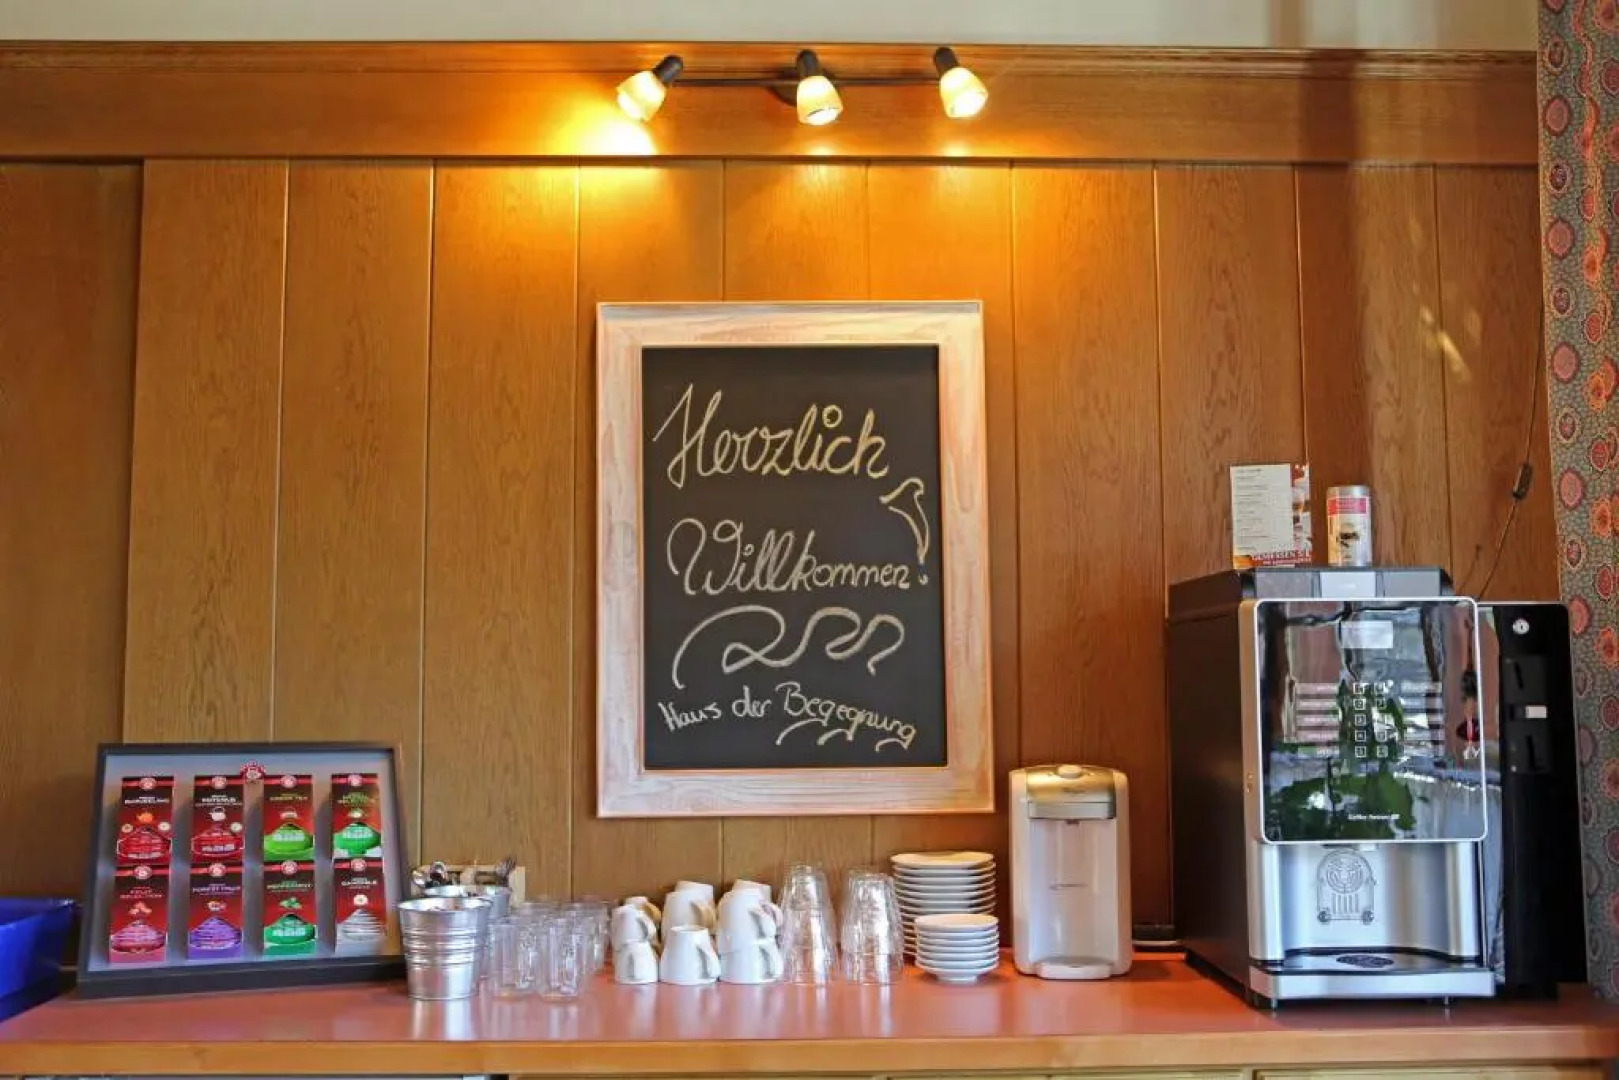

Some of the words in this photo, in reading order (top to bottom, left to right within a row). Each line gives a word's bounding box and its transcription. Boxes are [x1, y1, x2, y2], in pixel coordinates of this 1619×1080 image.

[652, 383, 890, 488] Herzlich
[657, 699, 722, 733] Haus
[731, 684, 773, 718] der
[775, 680, 917, 753] Begegnung
